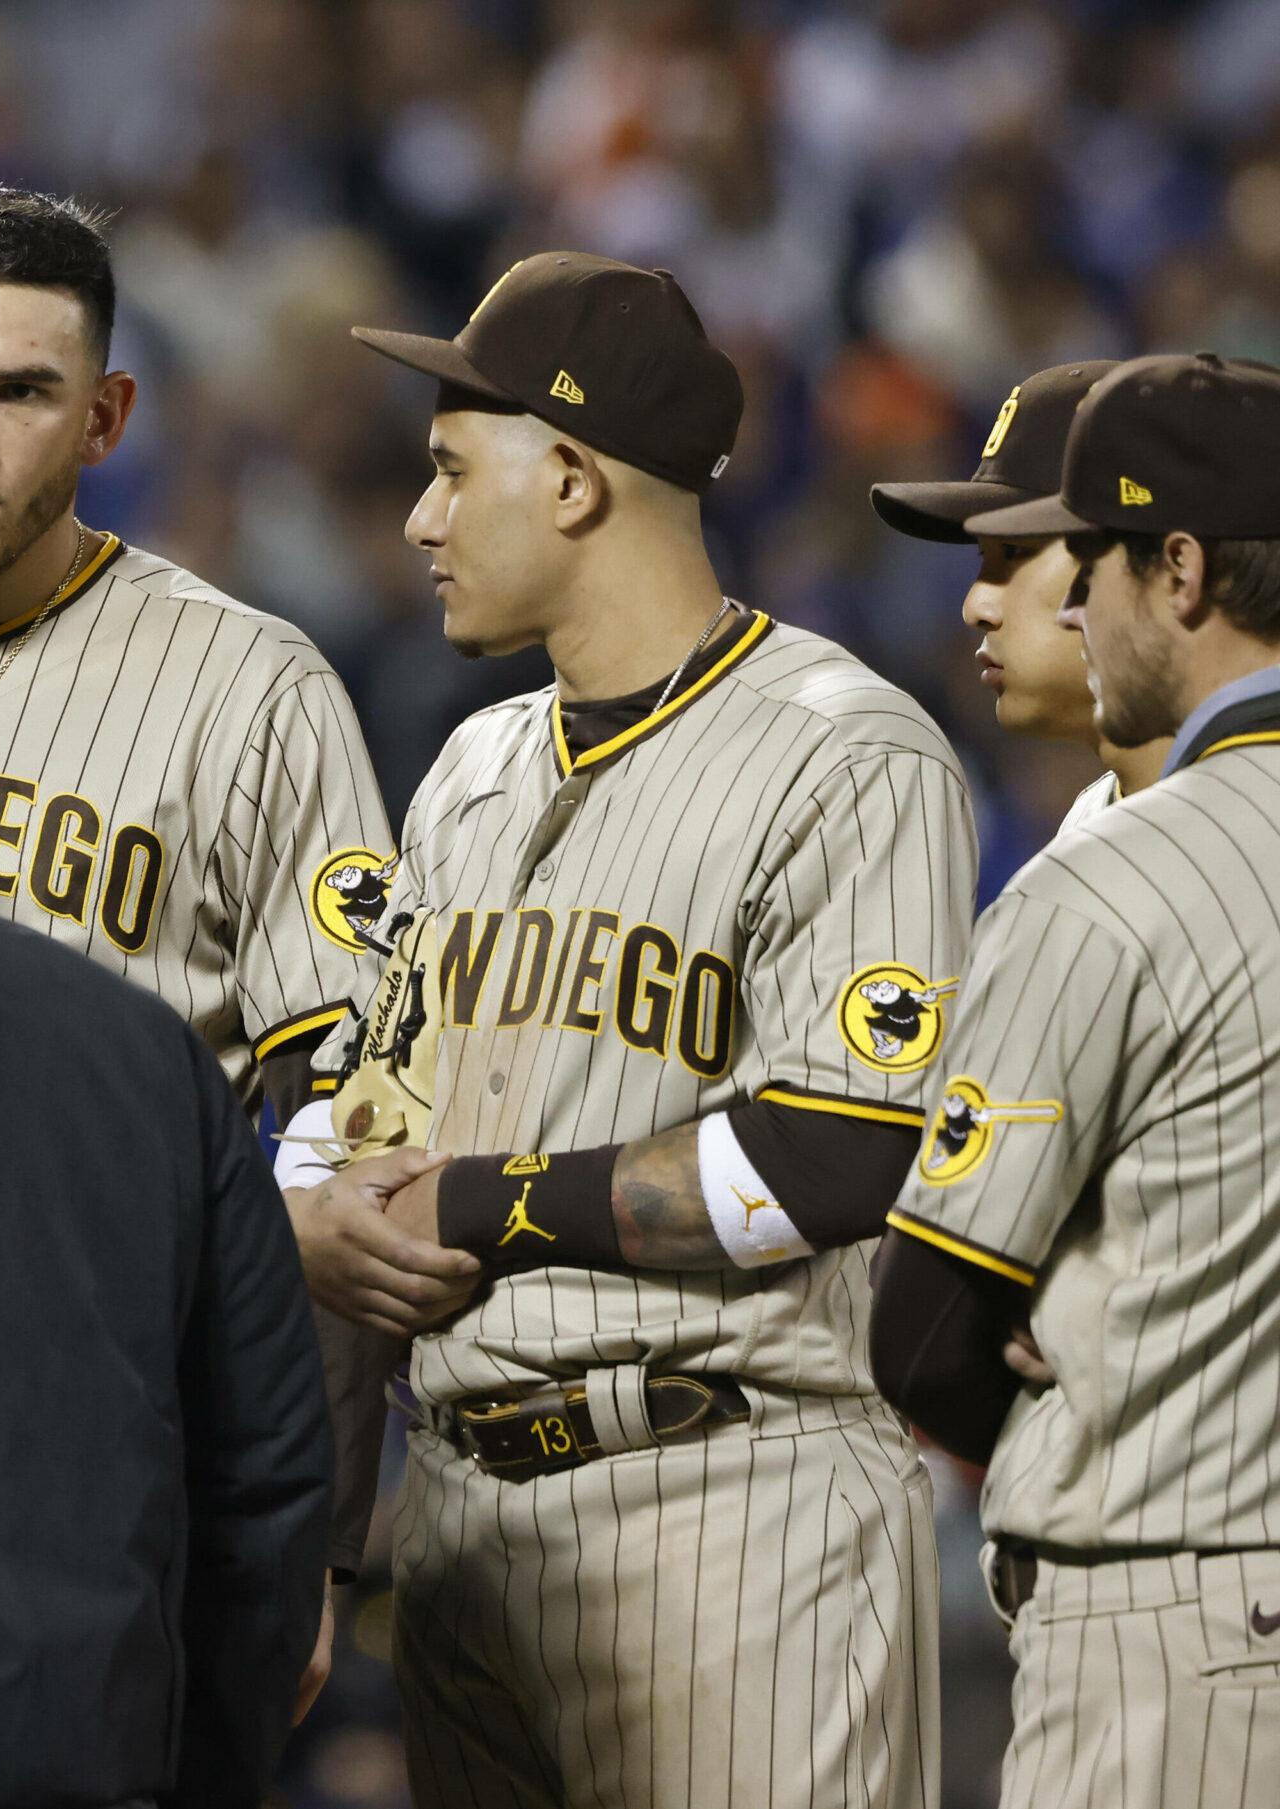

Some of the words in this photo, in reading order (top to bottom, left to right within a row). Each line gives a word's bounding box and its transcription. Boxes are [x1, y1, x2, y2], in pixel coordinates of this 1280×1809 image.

[363, 970, 403, 1063] Machado
[495, 906, 736, 1080] DIEGO
[530, 1416, 572, 1456] 13
